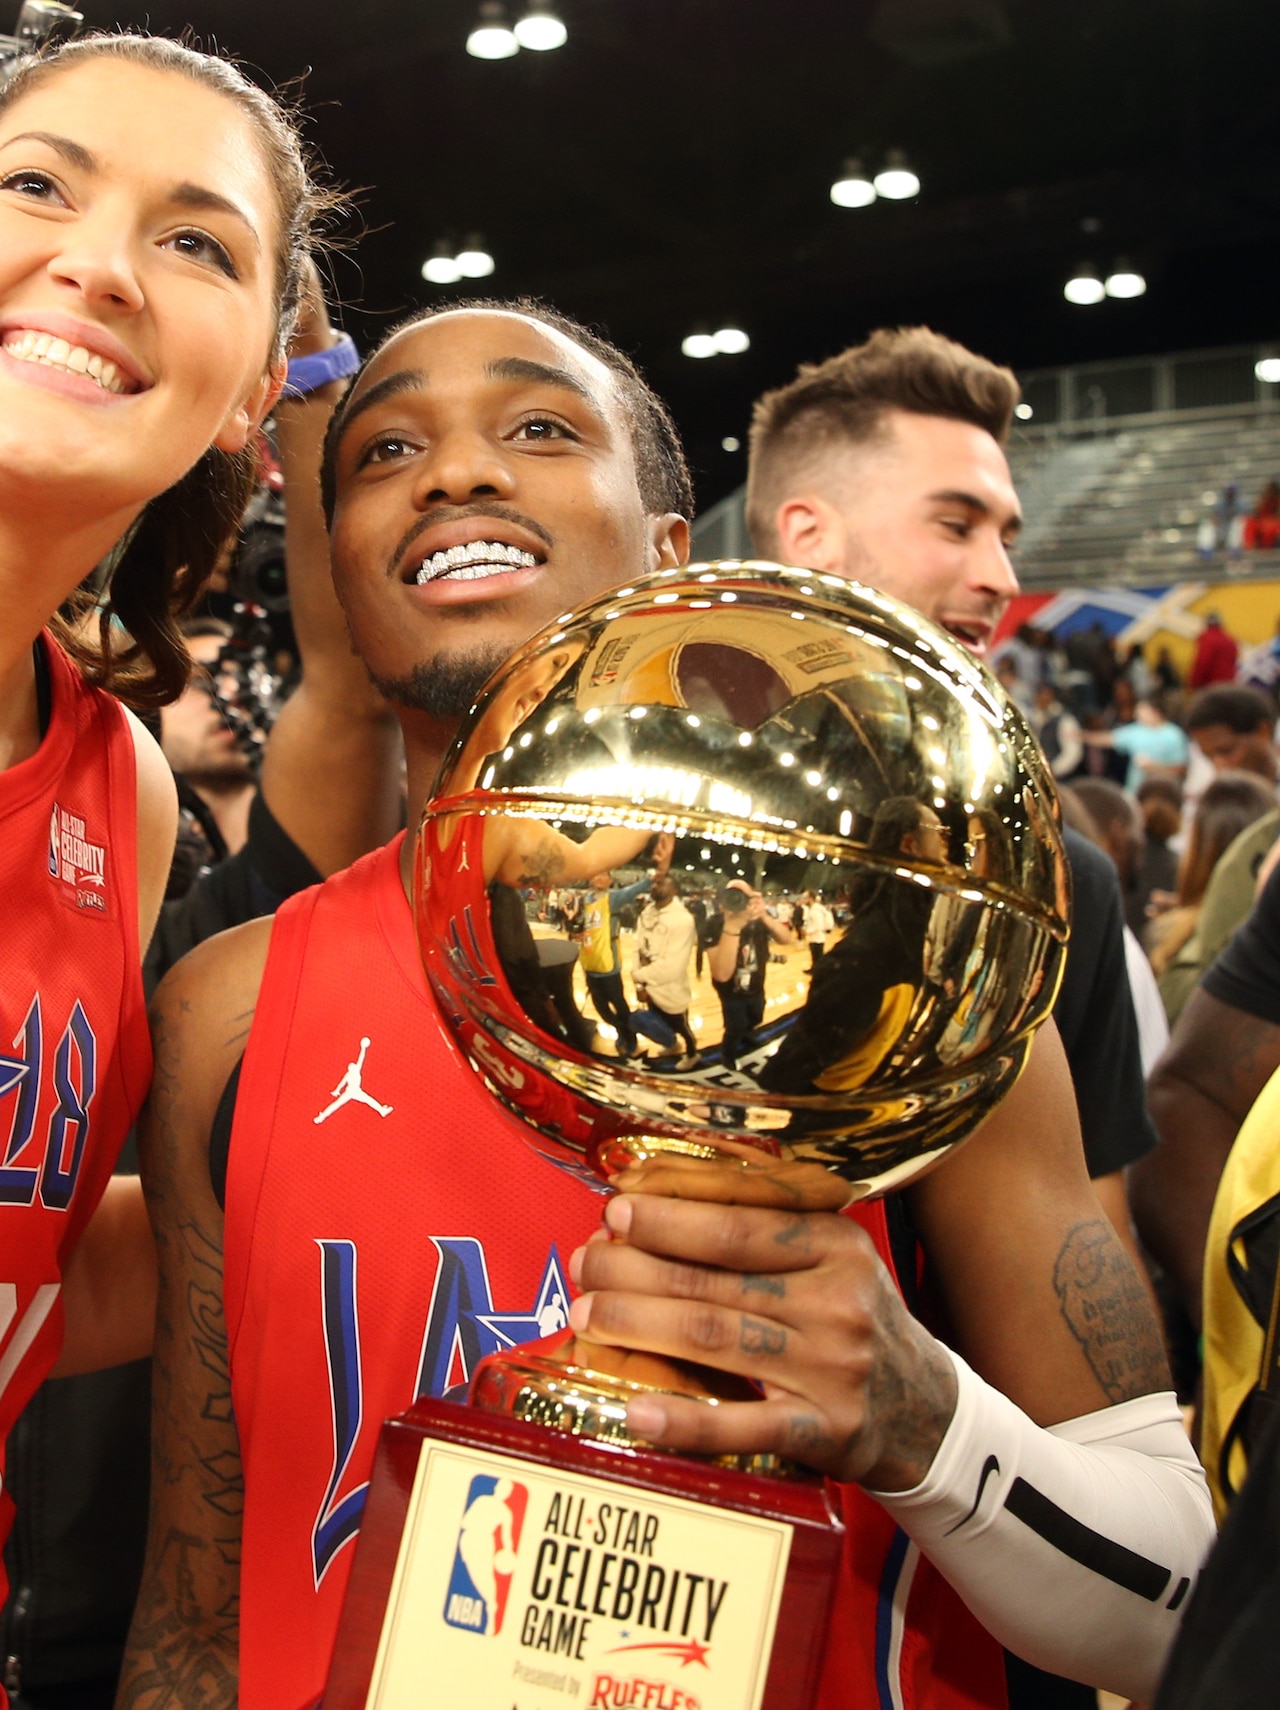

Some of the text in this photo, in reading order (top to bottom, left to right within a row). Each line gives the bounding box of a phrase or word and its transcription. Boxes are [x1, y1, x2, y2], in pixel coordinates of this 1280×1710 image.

[61, 829, 105, 877] CELEBRITY
[447, 1594, 484, 1629] NBA
[531, 1539, 729, 1642] CELEBRITY
[520, 1604, 593, 1661] GAME
